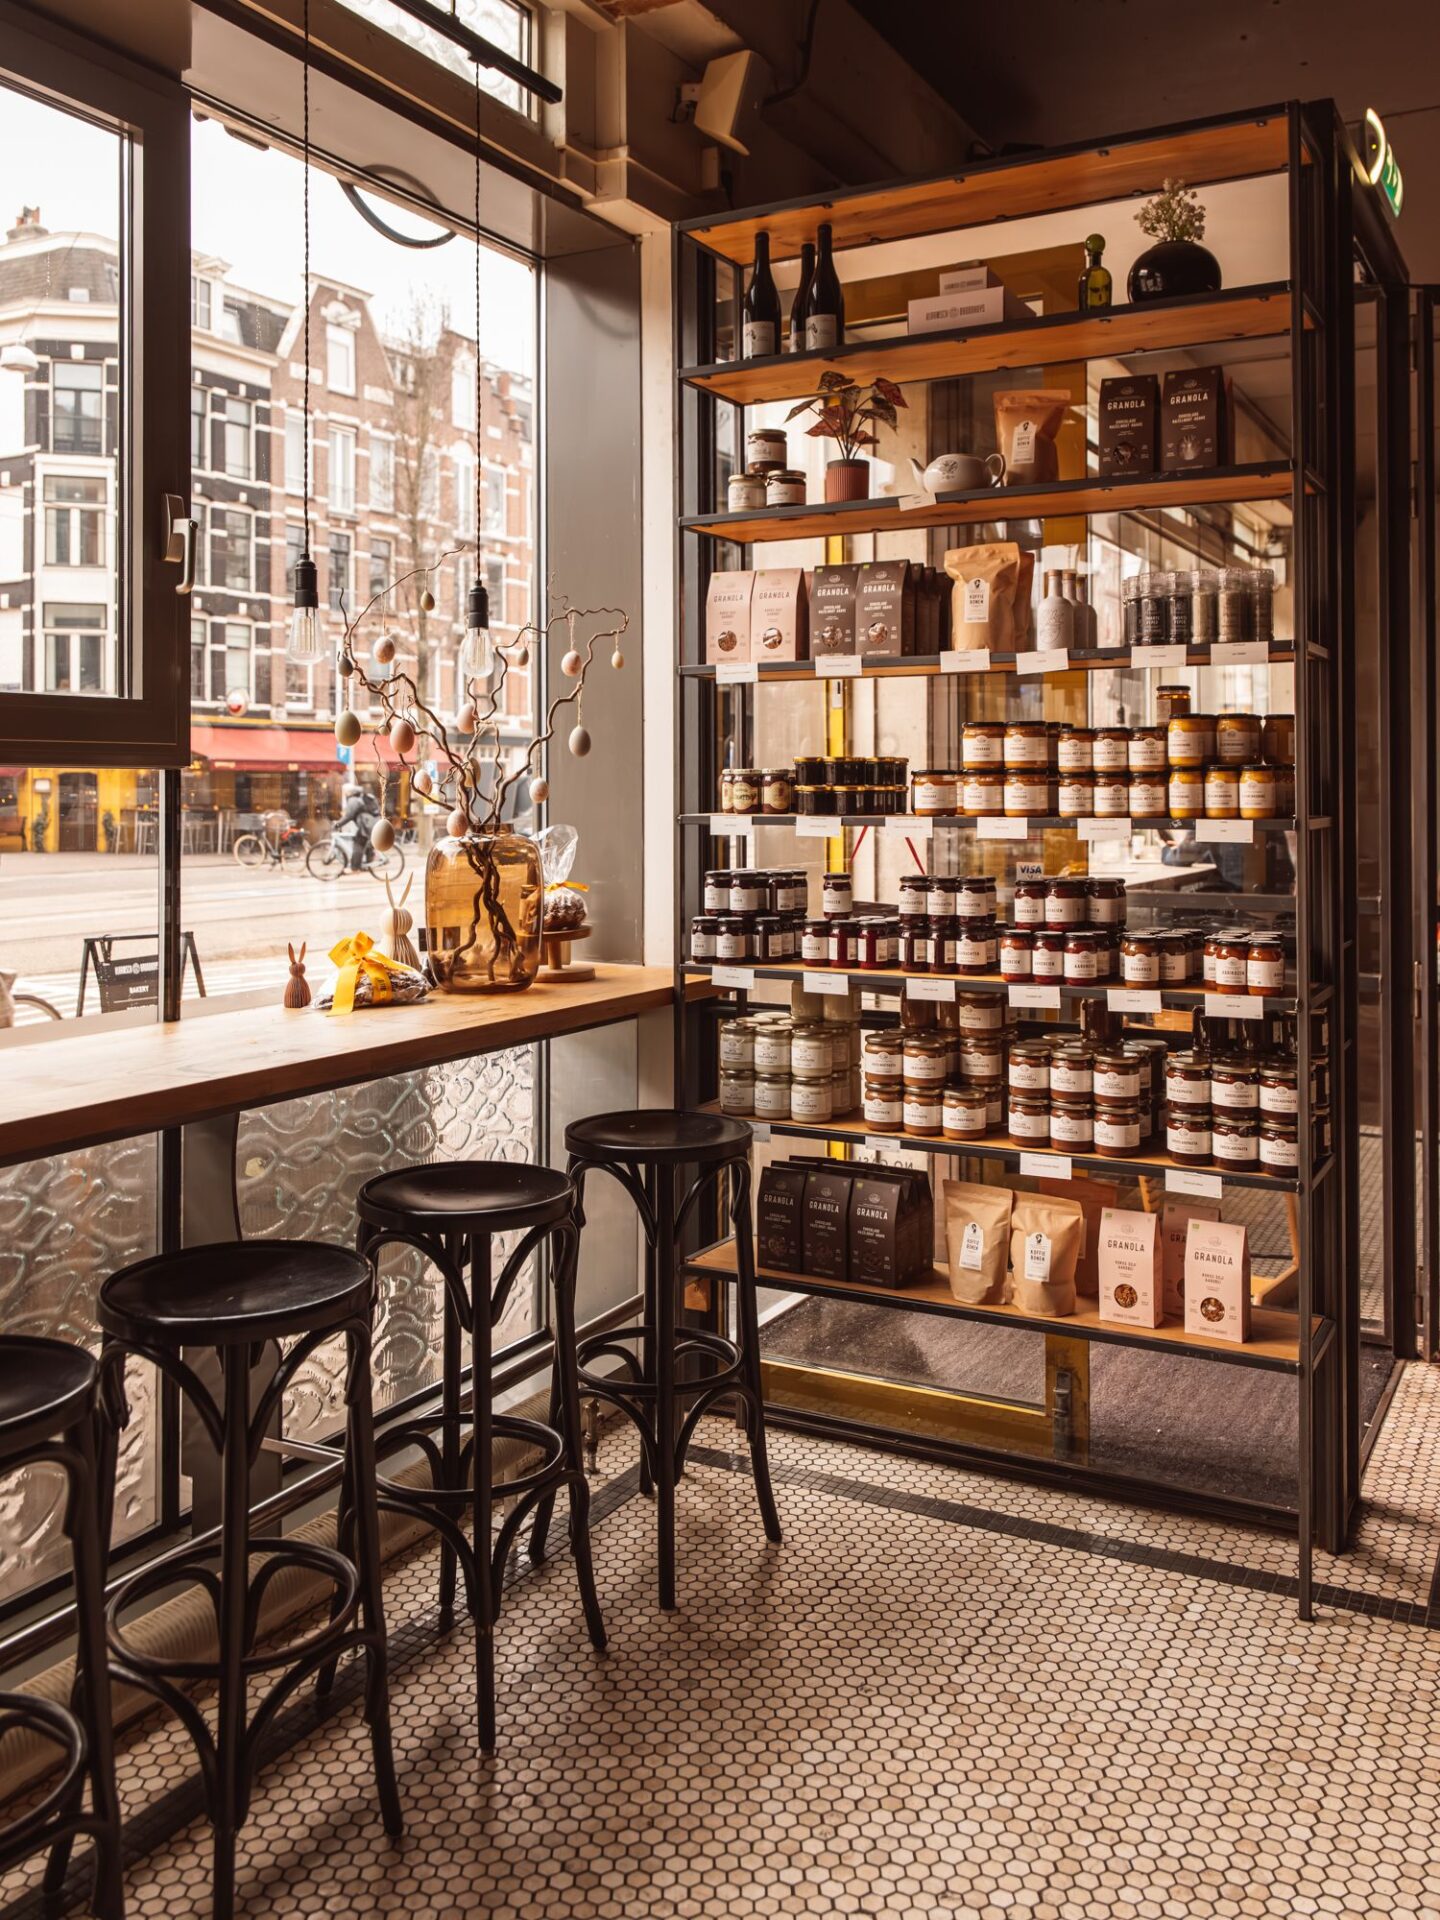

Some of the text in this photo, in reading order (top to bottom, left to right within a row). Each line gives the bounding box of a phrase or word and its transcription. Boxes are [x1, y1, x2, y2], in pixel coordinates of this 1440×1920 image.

[1170, 392, 1208, 405] GRANOLA
[1107, 400, 1145, 410] GRANOLA
[817, 587, 849, 597] GRANOLA
[863, 584, 895, 594] GRANOLA
[713, 594, 744, 603] GRANOLA
[759, 591, 790, 600] GRANOLA
[1020, 866, 1042, 874] VISA
[763, 1194, 794, 1206] GRANOLA
[809, 1201, 839, 1214] GRANOLA
[856, 1207, 888, 1220] GRANOLA
[1107, 1240, 1145, 1252] GRANOLA
[1194, 1251, 1233, 1265] GRANOLA
